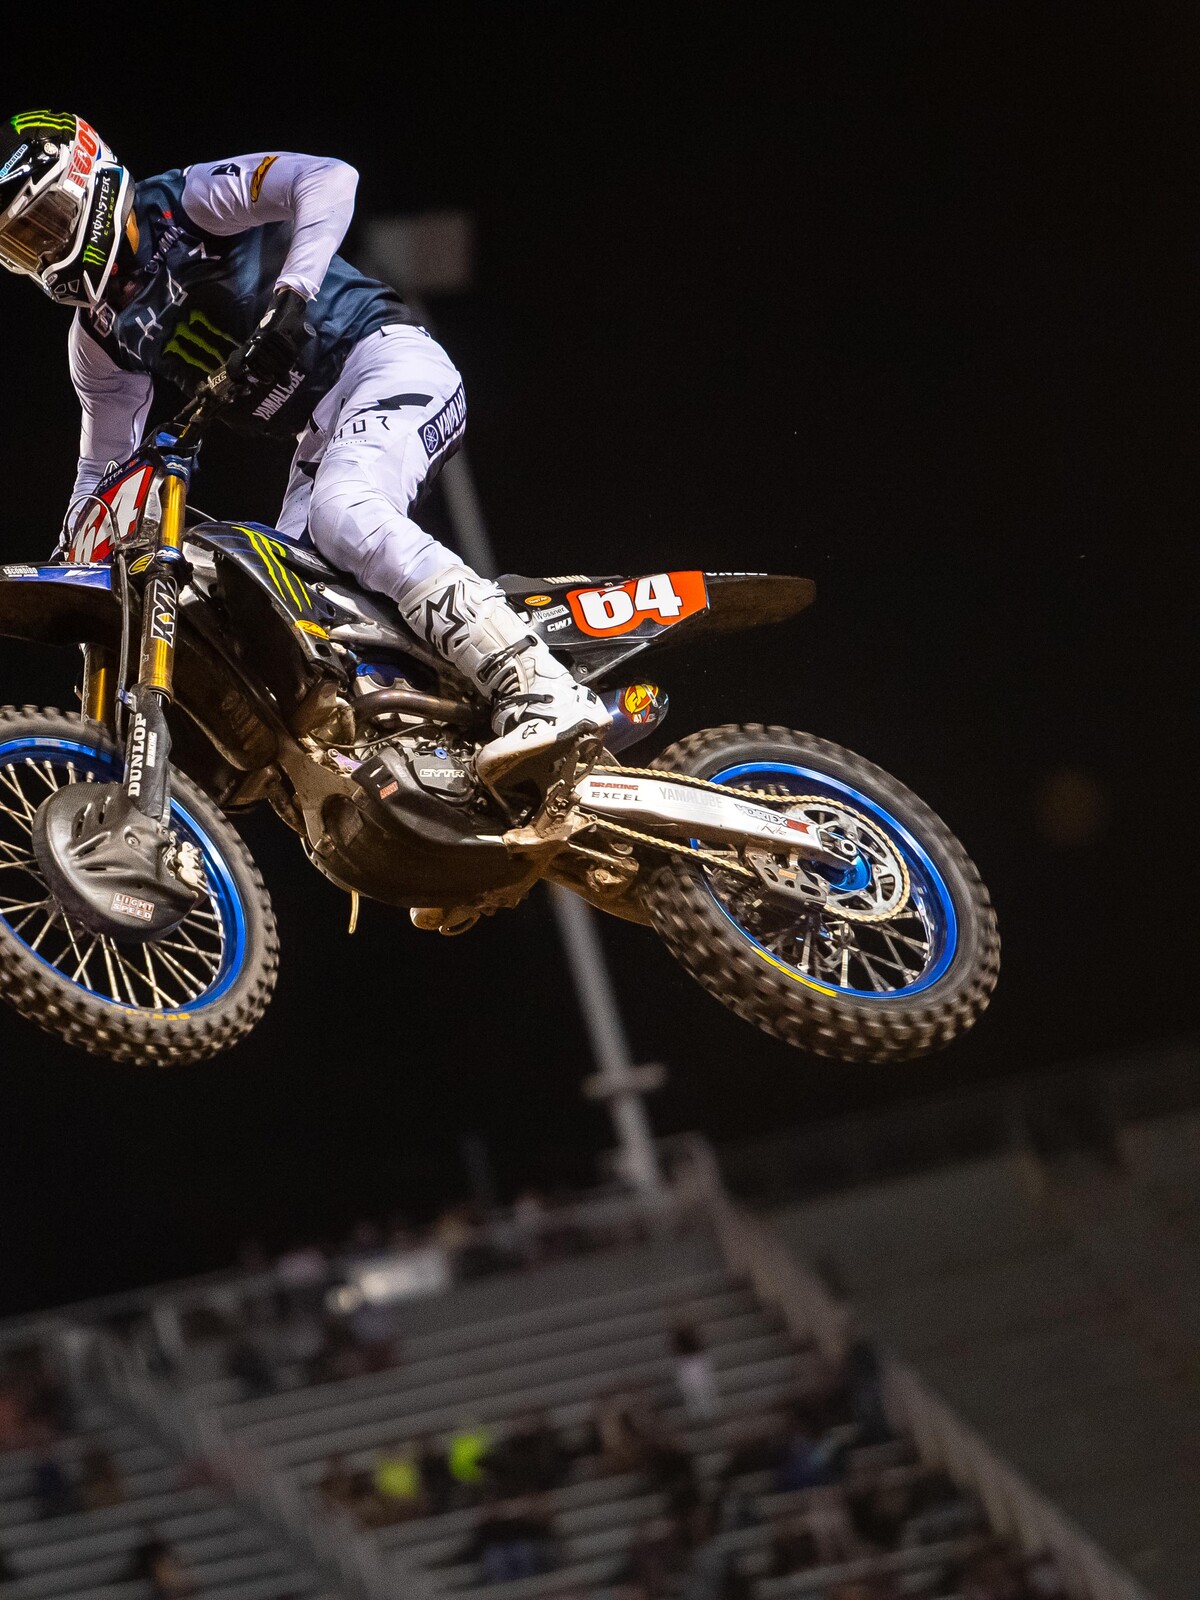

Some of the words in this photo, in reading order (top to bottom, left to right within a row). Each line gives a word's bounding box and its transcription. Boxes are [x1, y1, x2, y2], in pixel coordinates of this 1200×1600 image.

[577, 573, 683, 629] 64
[128, 713, 146, 797] DUNLOP
[420, 769, 465, 778] GYTR
[590, 781, 639, 790] BRAKING
[591, 791, 643, 802] EXCEL
[659, 786, 724, 809] YAMALUBE
[115, 894, 153, 911] LIGHT
[112, 903, 151, 919] SPEED
